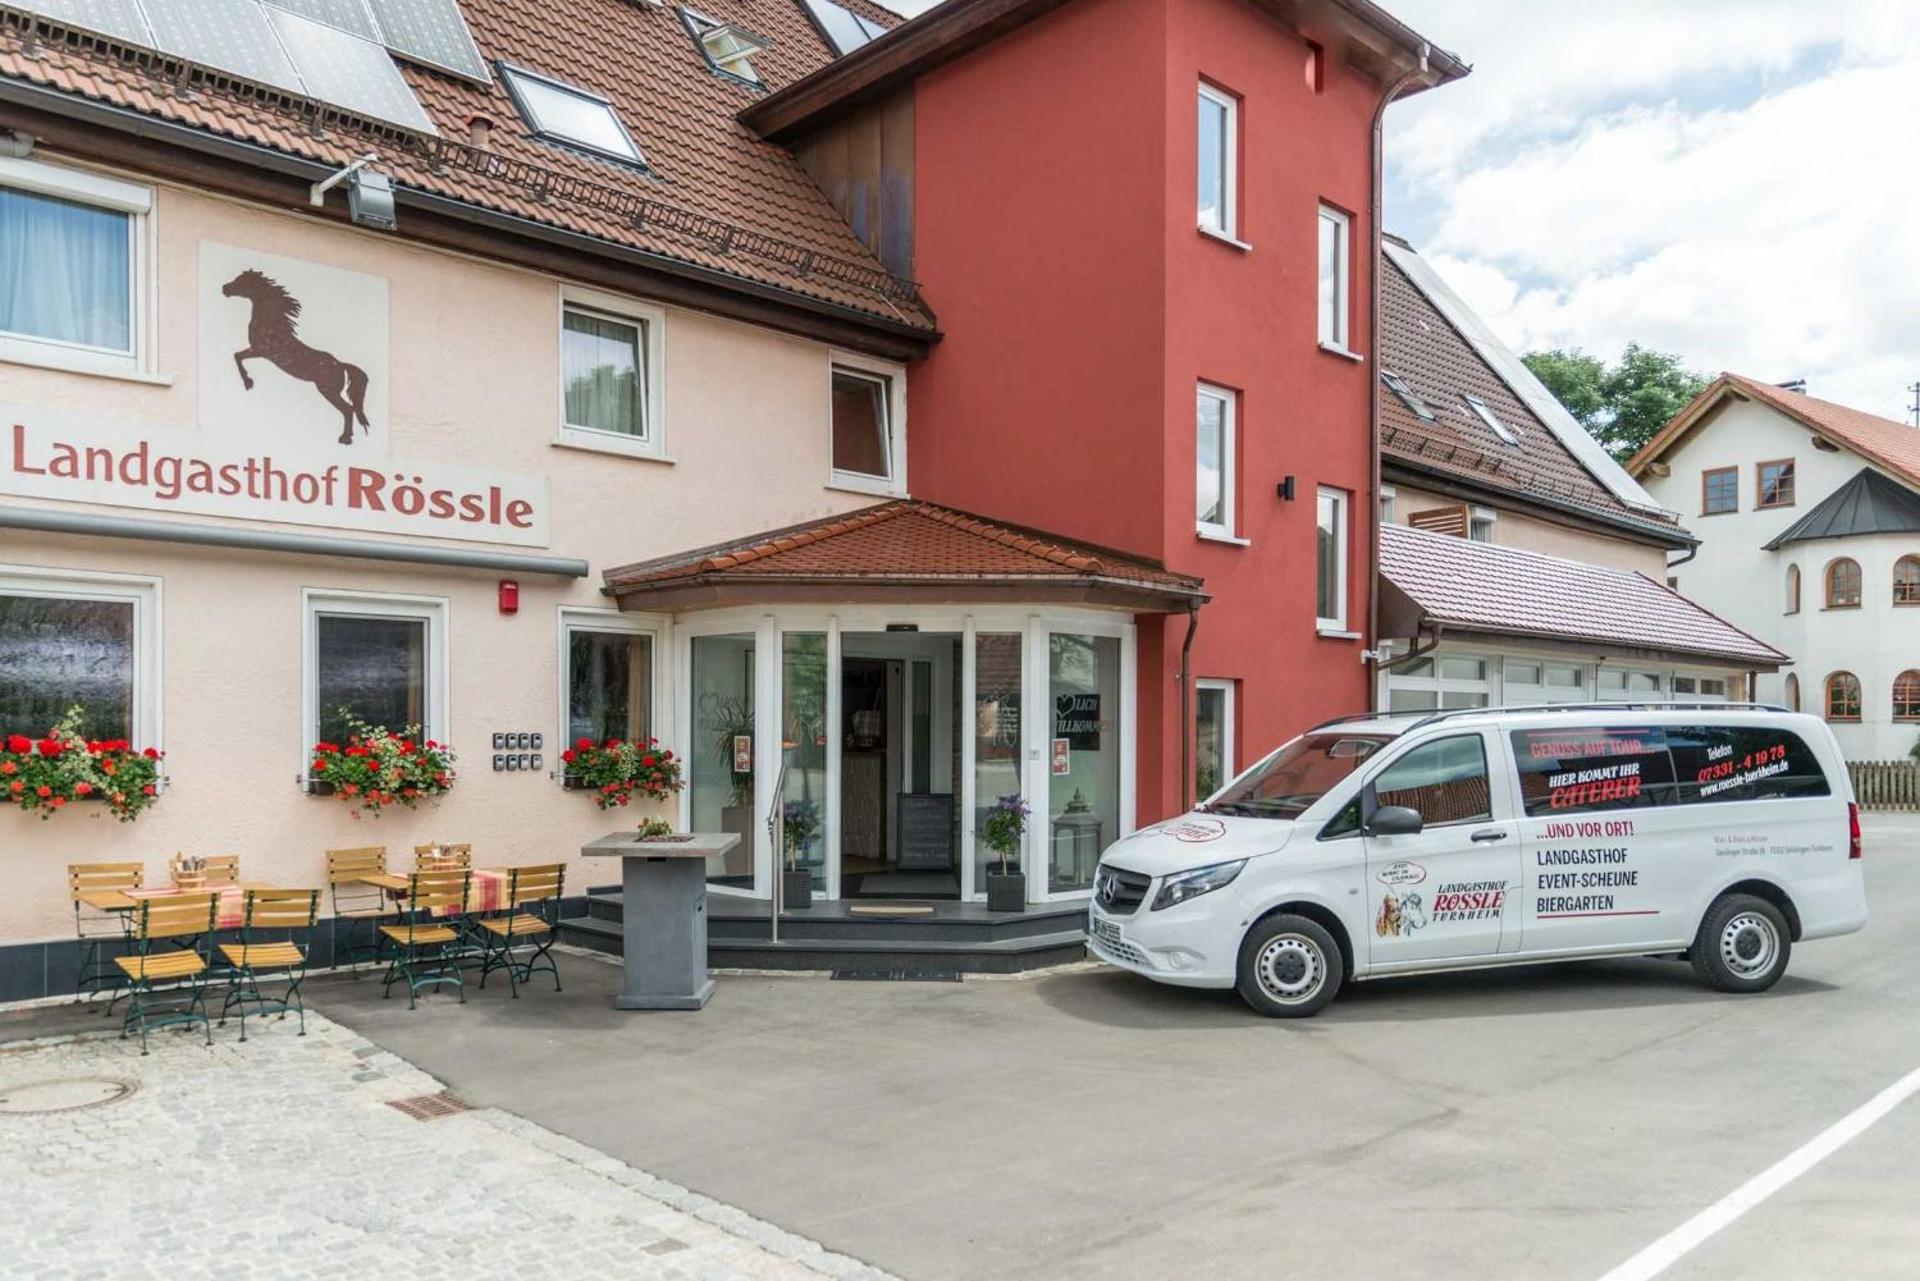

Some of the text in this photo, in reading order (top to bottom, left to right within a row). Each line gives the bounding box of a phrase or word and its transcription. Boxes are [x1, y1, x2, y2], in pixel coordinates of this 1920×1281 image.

[13, 424, 534, 528] Landgasthof Rössle
[1530, 741, 1581, 758] GENUSS
[1584, 740, 1608, 756] AUF
[1706, 744, 1733, 761] Telefon
[1698, 761, 1733, 783] 07331
[1743, 755, 1752, 769] 4
[1755, 750, 1768, 765] 19
[1770, 744, 1786, 760] 78
[1549, 762, 1640, 788] HIER KOMMT IHR
[1549, 776, 1641, 809] CATERER
[1536, 820, 1635, 839] ...UND VOR ORT!
[1536, 847, 1628, 866] LANDGASTHOF
[1438, 880, 1508, 893] LANDGASTHOF
[1537, 870, 1639, 889] EVENT-SCHEUNE
[1536, 894, 1614, 913] BIERGARTEN
